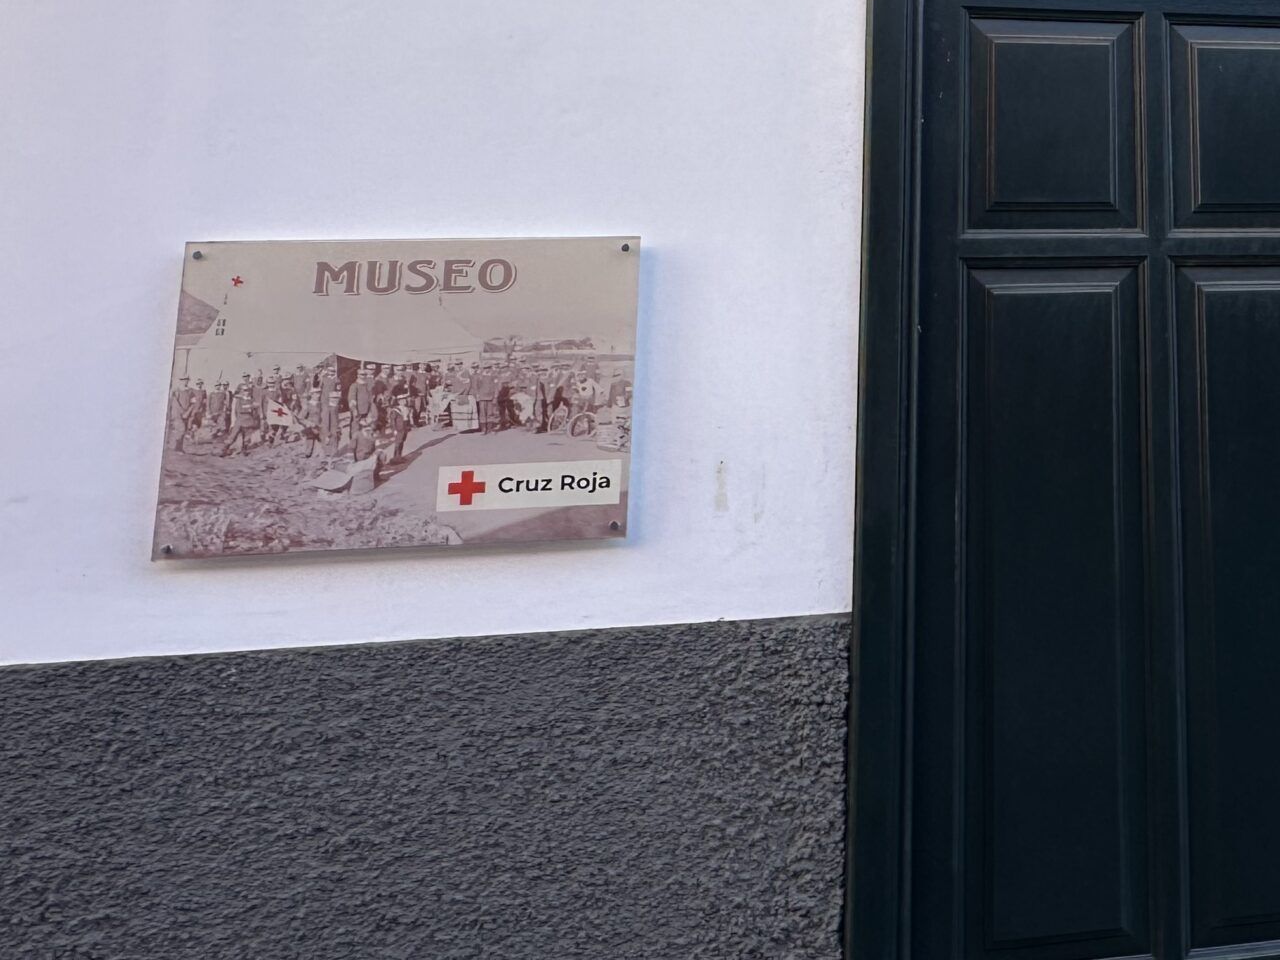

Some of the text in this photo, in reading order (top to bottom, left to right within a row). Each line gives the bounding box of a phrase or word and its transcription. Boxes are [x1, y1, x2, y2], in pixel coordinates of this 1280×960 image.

[312, 258, 517, 296] MUSEO
[498, 471, 611, 493] Cruz Roja
